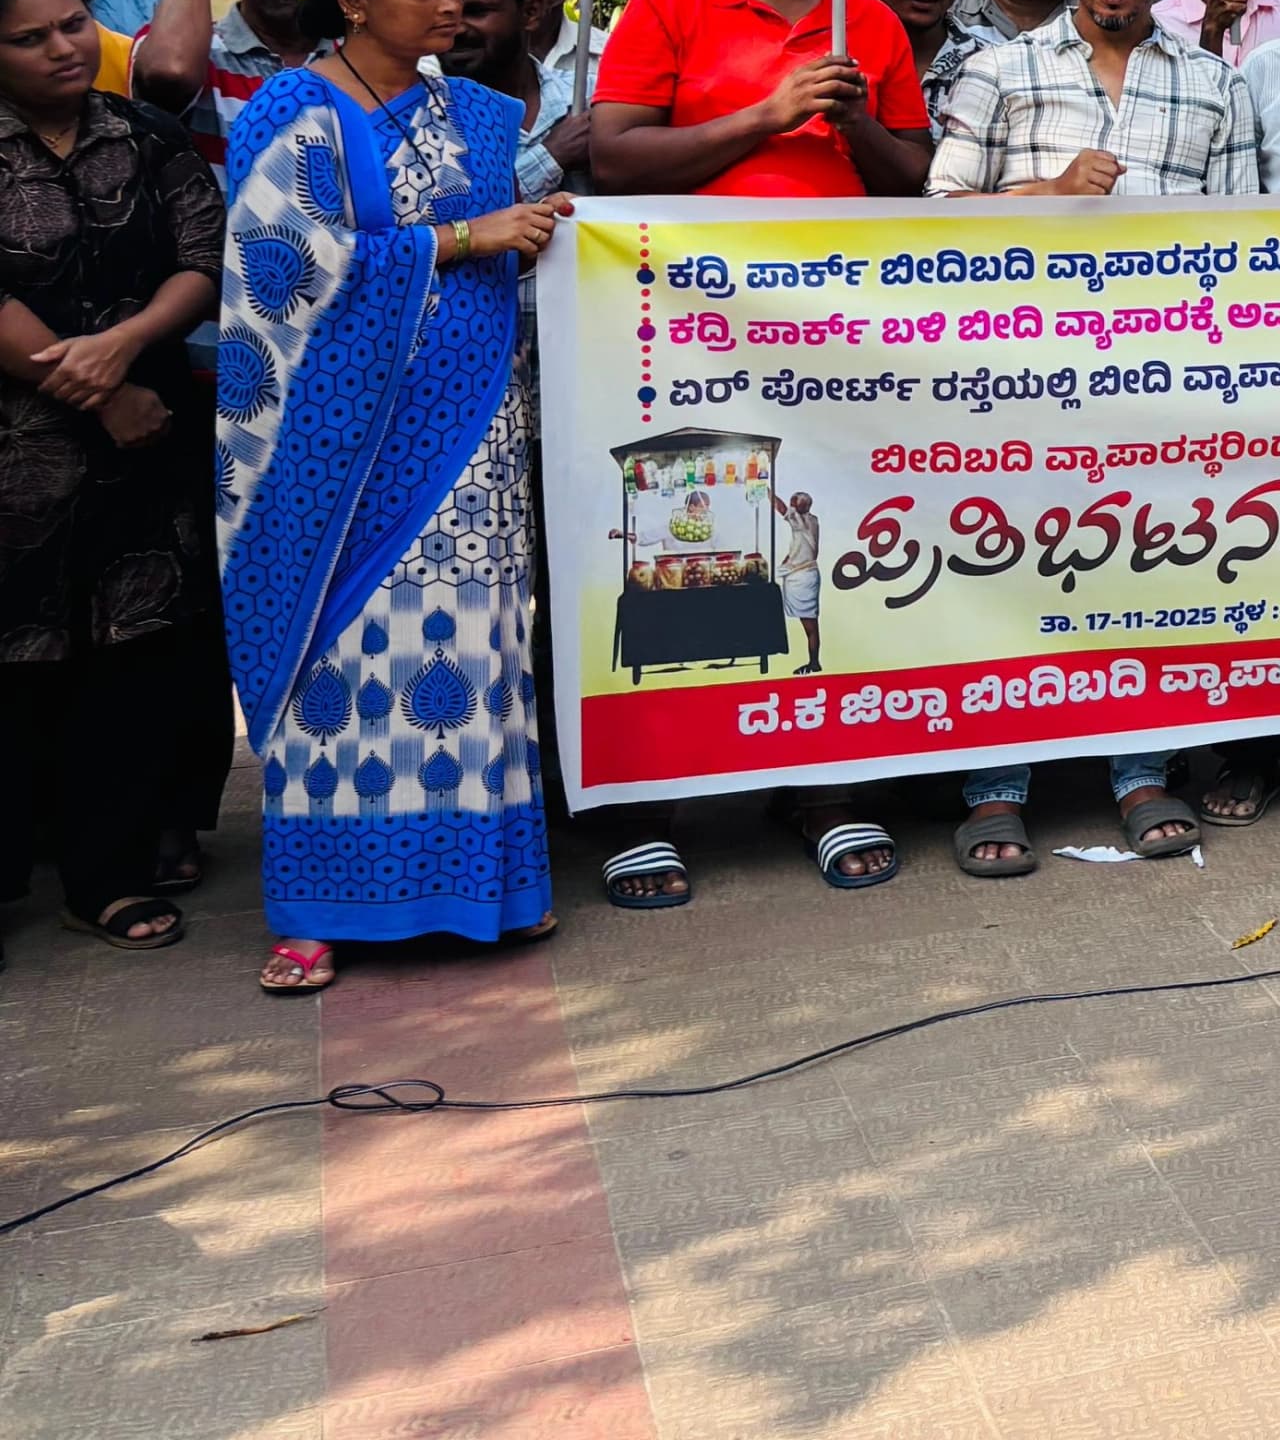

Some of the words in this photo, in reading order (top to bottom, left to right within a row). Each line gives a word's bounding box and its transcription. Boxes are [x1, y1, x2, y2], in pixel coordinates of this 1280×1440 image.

[667, 255, 736, 299] ಕದ್ರಿ
[747, 253, 869, 289] ಪಾರ್ಕ್
[880, 247, 1035, 285] ಬೀದಿಬದಿ
[1047, 241, 1238, 292] ವ್ಯಾಪಾರಸ್ಥರ
[669, 312, 736, 351] ಕದ್ರಿ
[747, 313, 870, 346] ಪಾರ್ಕ್
[882, 311, 946, 344] ಬಳಿ
[958, 306, 1043, 341] ಬೀದಿ
[1055, 295, 1223, 350] ವ್ಯಾಪಾರಕ್ಕೆ
[669, 369, 749, 406] ಏರ್
[761, 368, 920, 406] ಪೋರ್ಟ್
[932, 366, 1082, 413] ರಸ್ತೆಯಲ್ಲಿ
[1089, 360, 1172, 397] ಬೀದಿ
[871, 439, 1033, 474] ಬೀದಿಬದಿ
[1040, 615, 1077, 633] ತಾ.
[1086, 607, 1216, 631] 17-11-2025
[1224, 600, 1266, 634] ಸ್ಥಳ
[738, 689, 827, 736] ದ.ಕ
[840, 684, 953, 732] ಜಿಲ್ಲಾ
[961, 658, 1146, 713] ಬೀದಿಬದಿ
